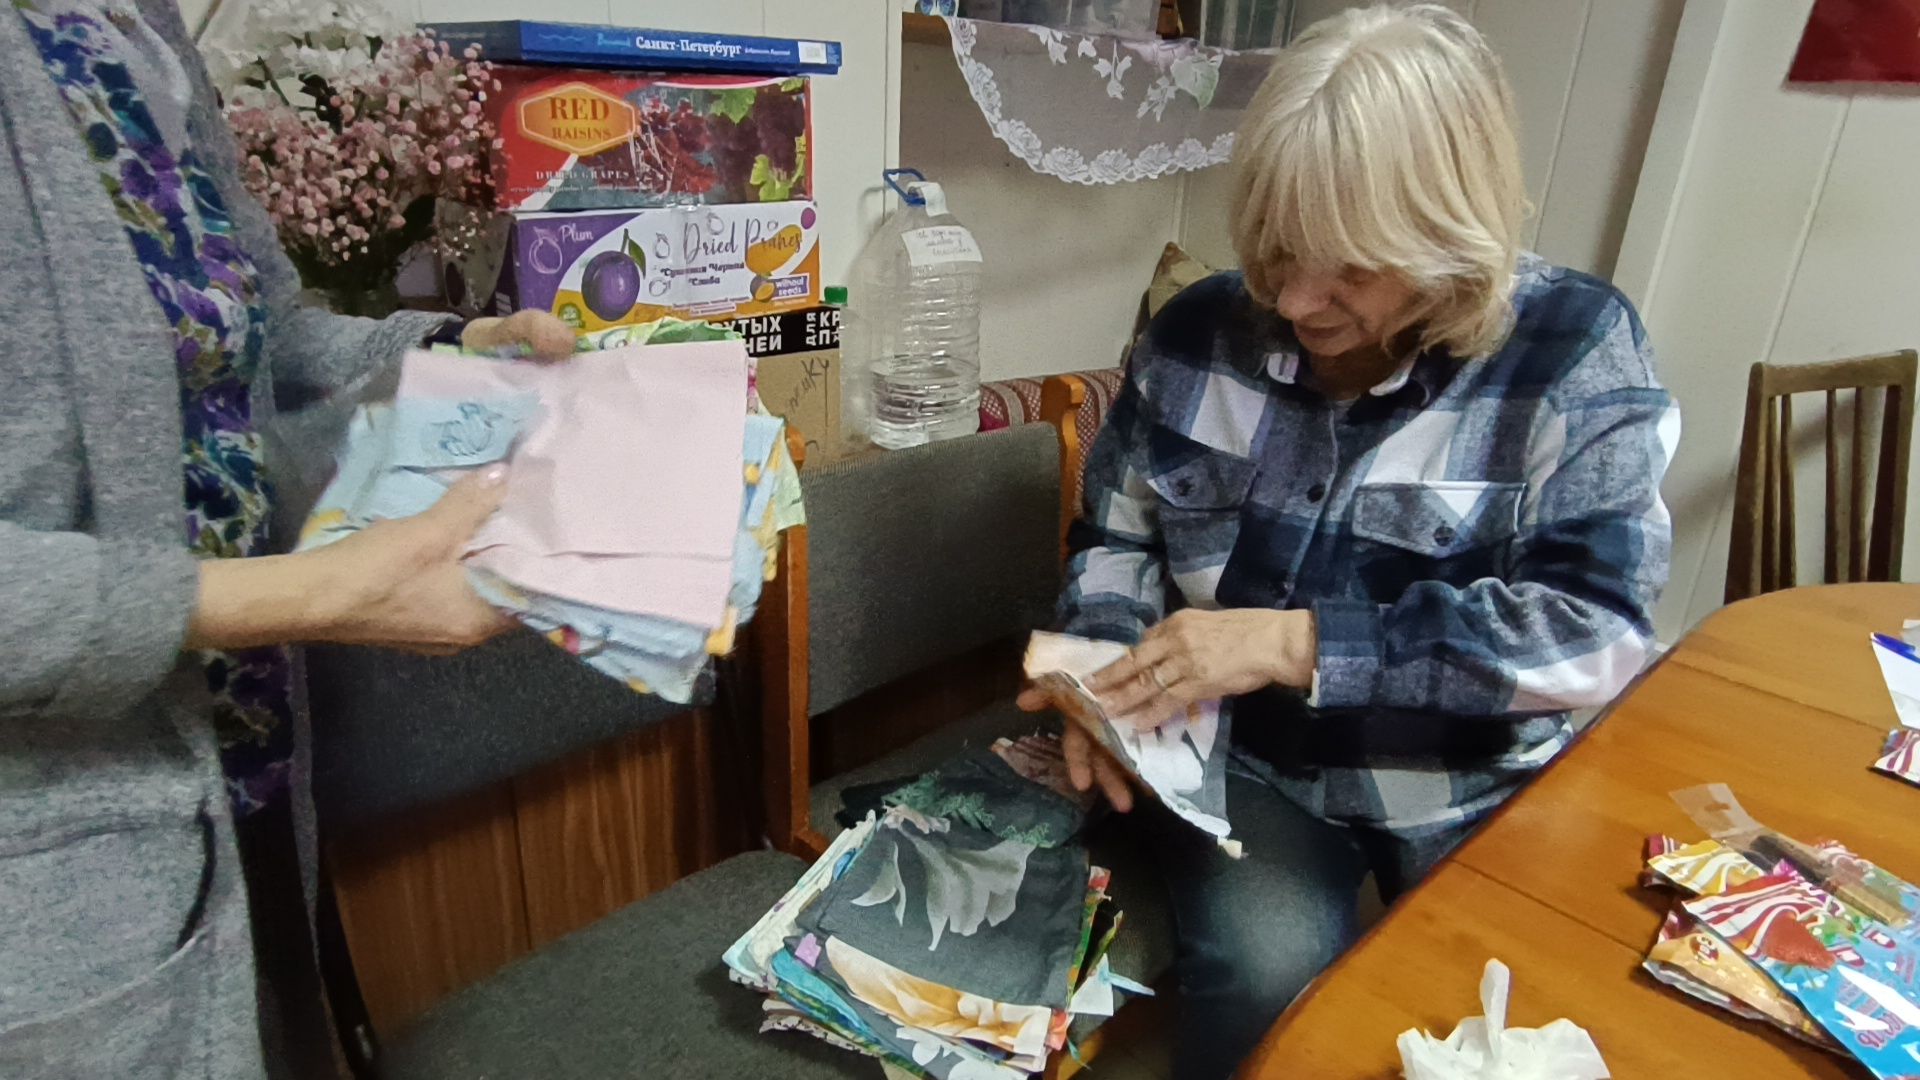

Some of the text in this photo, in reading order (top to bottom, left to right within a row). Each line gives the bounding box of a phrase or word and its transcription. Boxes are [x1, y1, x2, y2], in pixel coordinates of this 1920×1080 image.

[635, 36, 741, 57] Санкт-Петербург
[550, 97, 610, 120] RED
[552, 127, 612, 140] RAISINS
[535, 170, 630, 180] DRIED GRAPES
[559, 223, 594, 243] Plum
[683, 221, 737, 264] Dried
[778, 286, 802, 296] seeds
[806, 312, 817, 346] ДЛЯ
